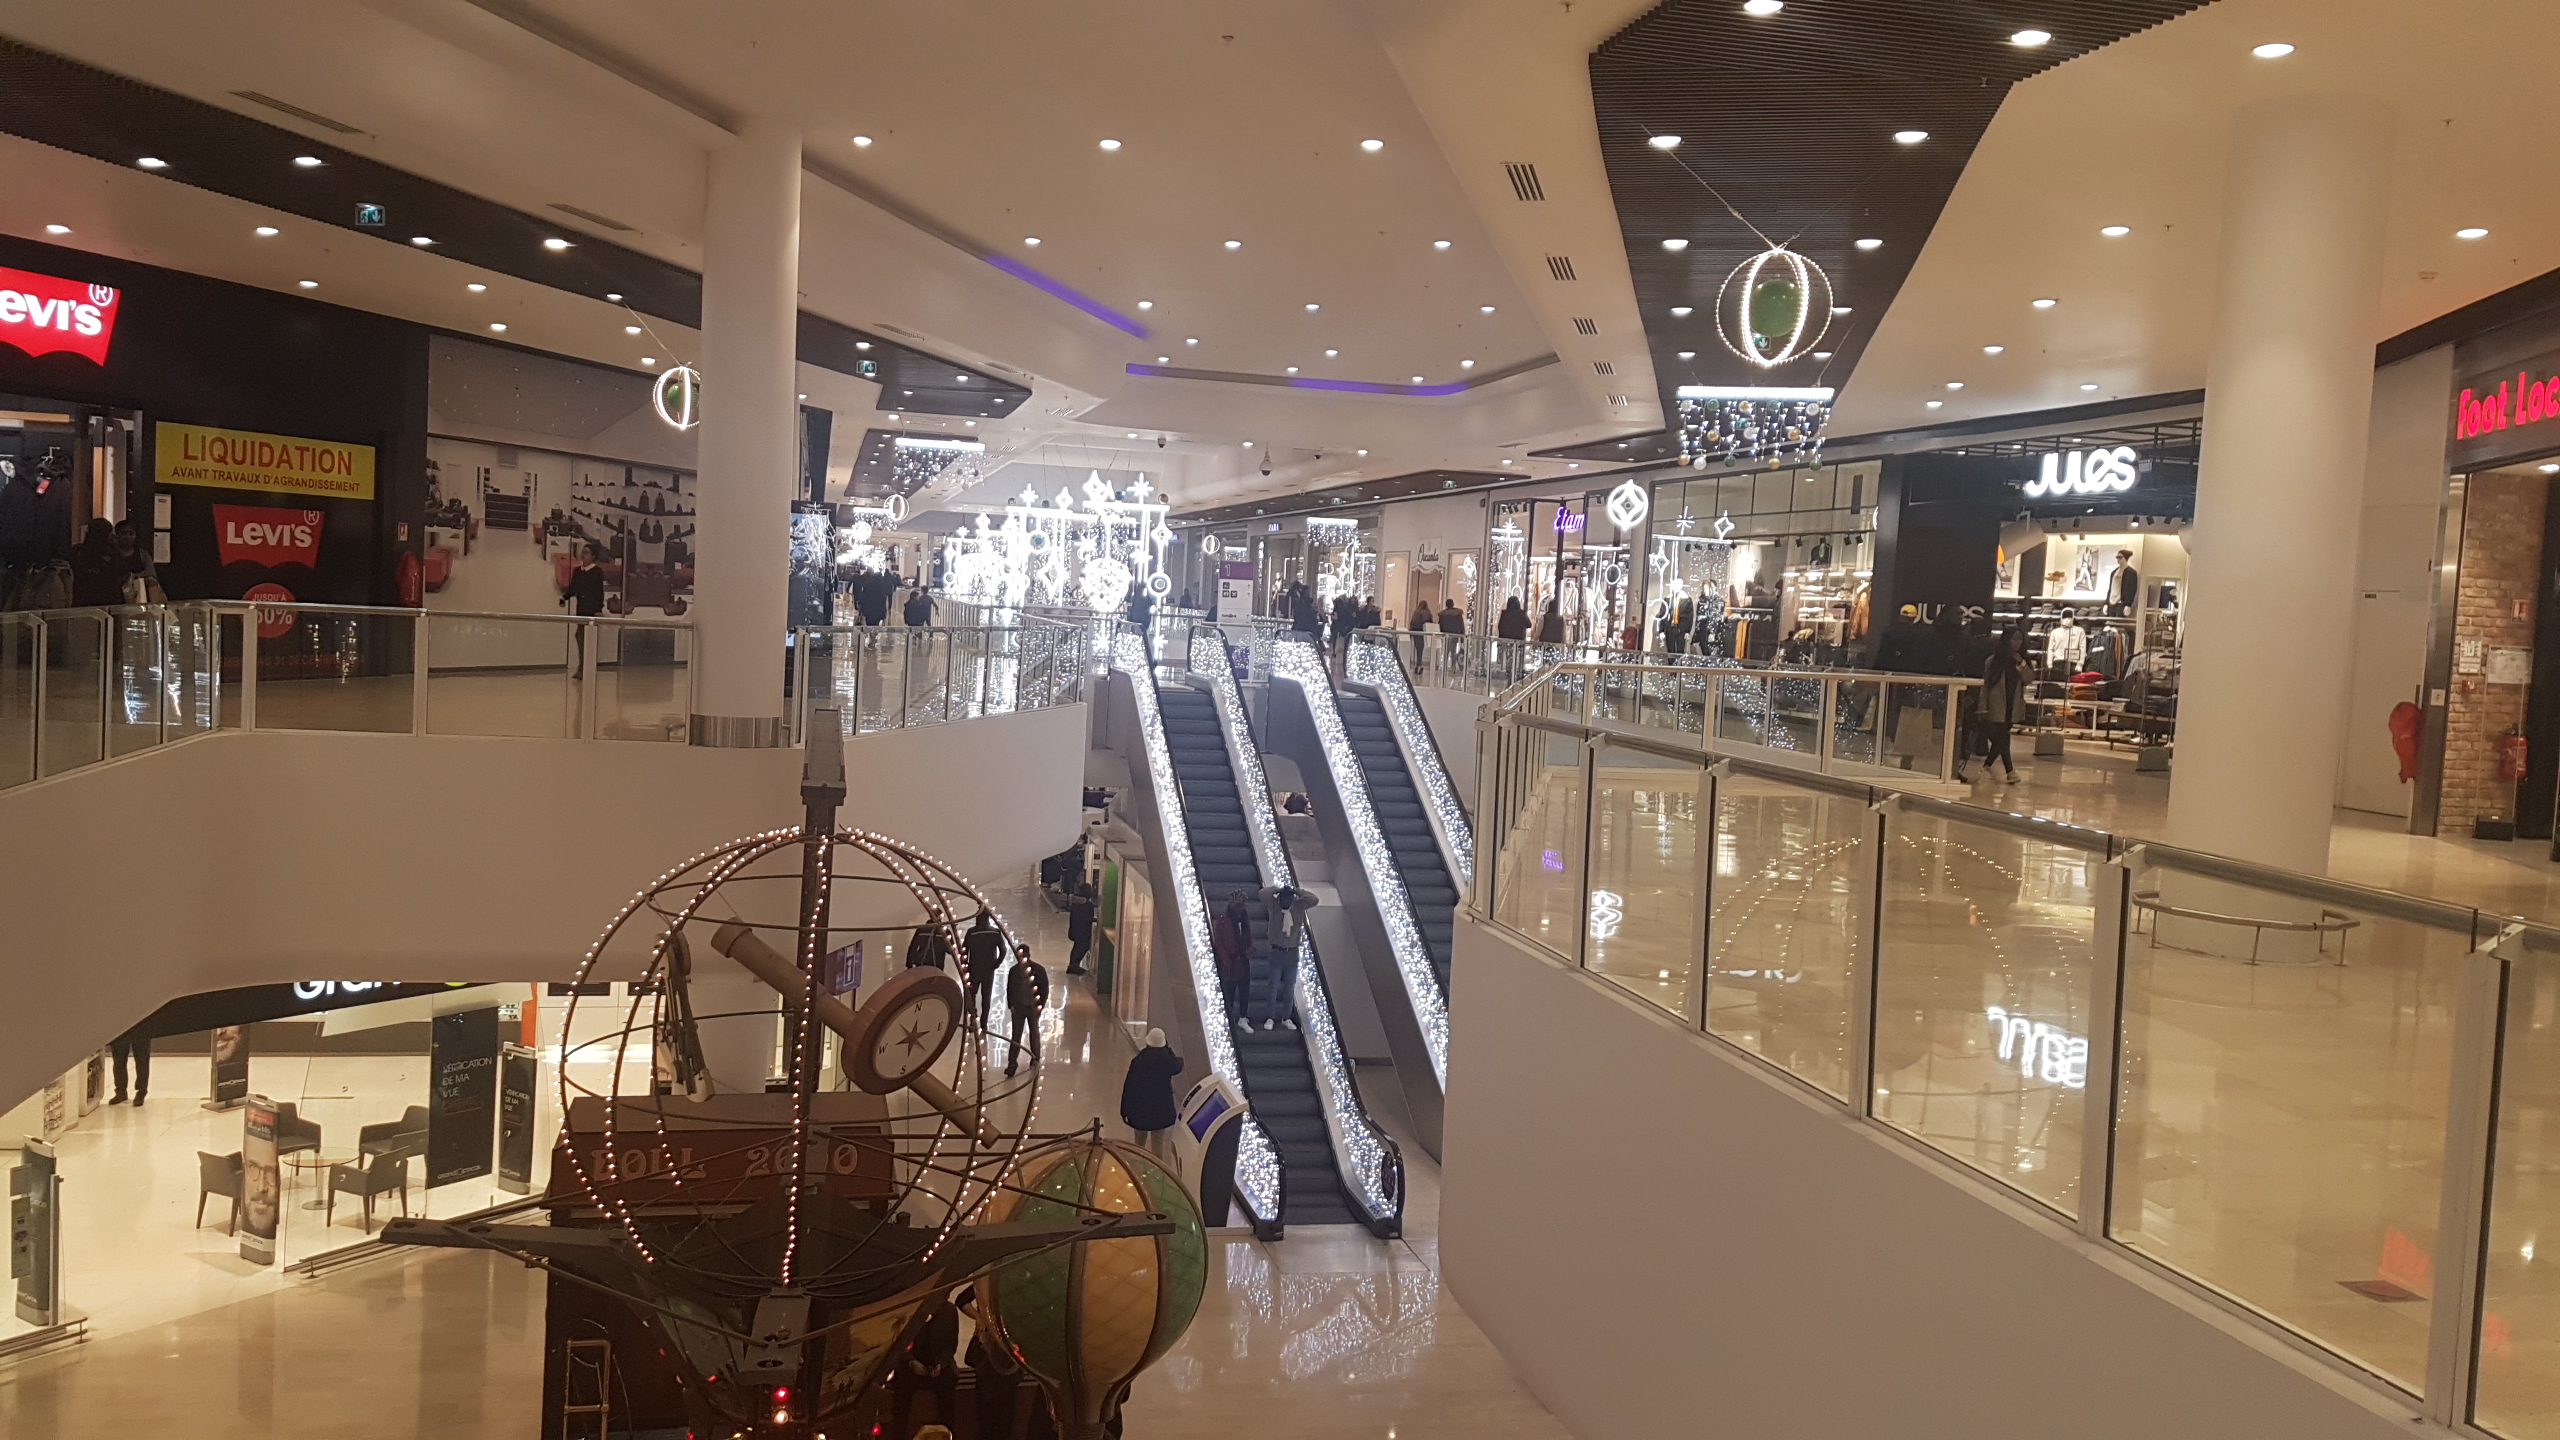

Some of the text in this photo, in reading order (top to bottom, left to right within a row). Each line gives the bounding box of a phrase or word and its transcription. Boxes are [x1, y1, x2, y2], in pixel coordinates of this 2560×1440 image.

[2457, 371, 2560, 440] Foot Loc
[183, 433, 352, 476] LIQUIDATION
[172, 466, 360, 493] AVANT TRAVAUX D'AGRANDISSEMENT
[1553, 506, 1586, 530] Etam
[914, 1002, 923, 1013] N
[878, 1042, 888, 1055] W
[900, 1065, 907, 1075] S
[745, 1144, 858, 1179] 200
